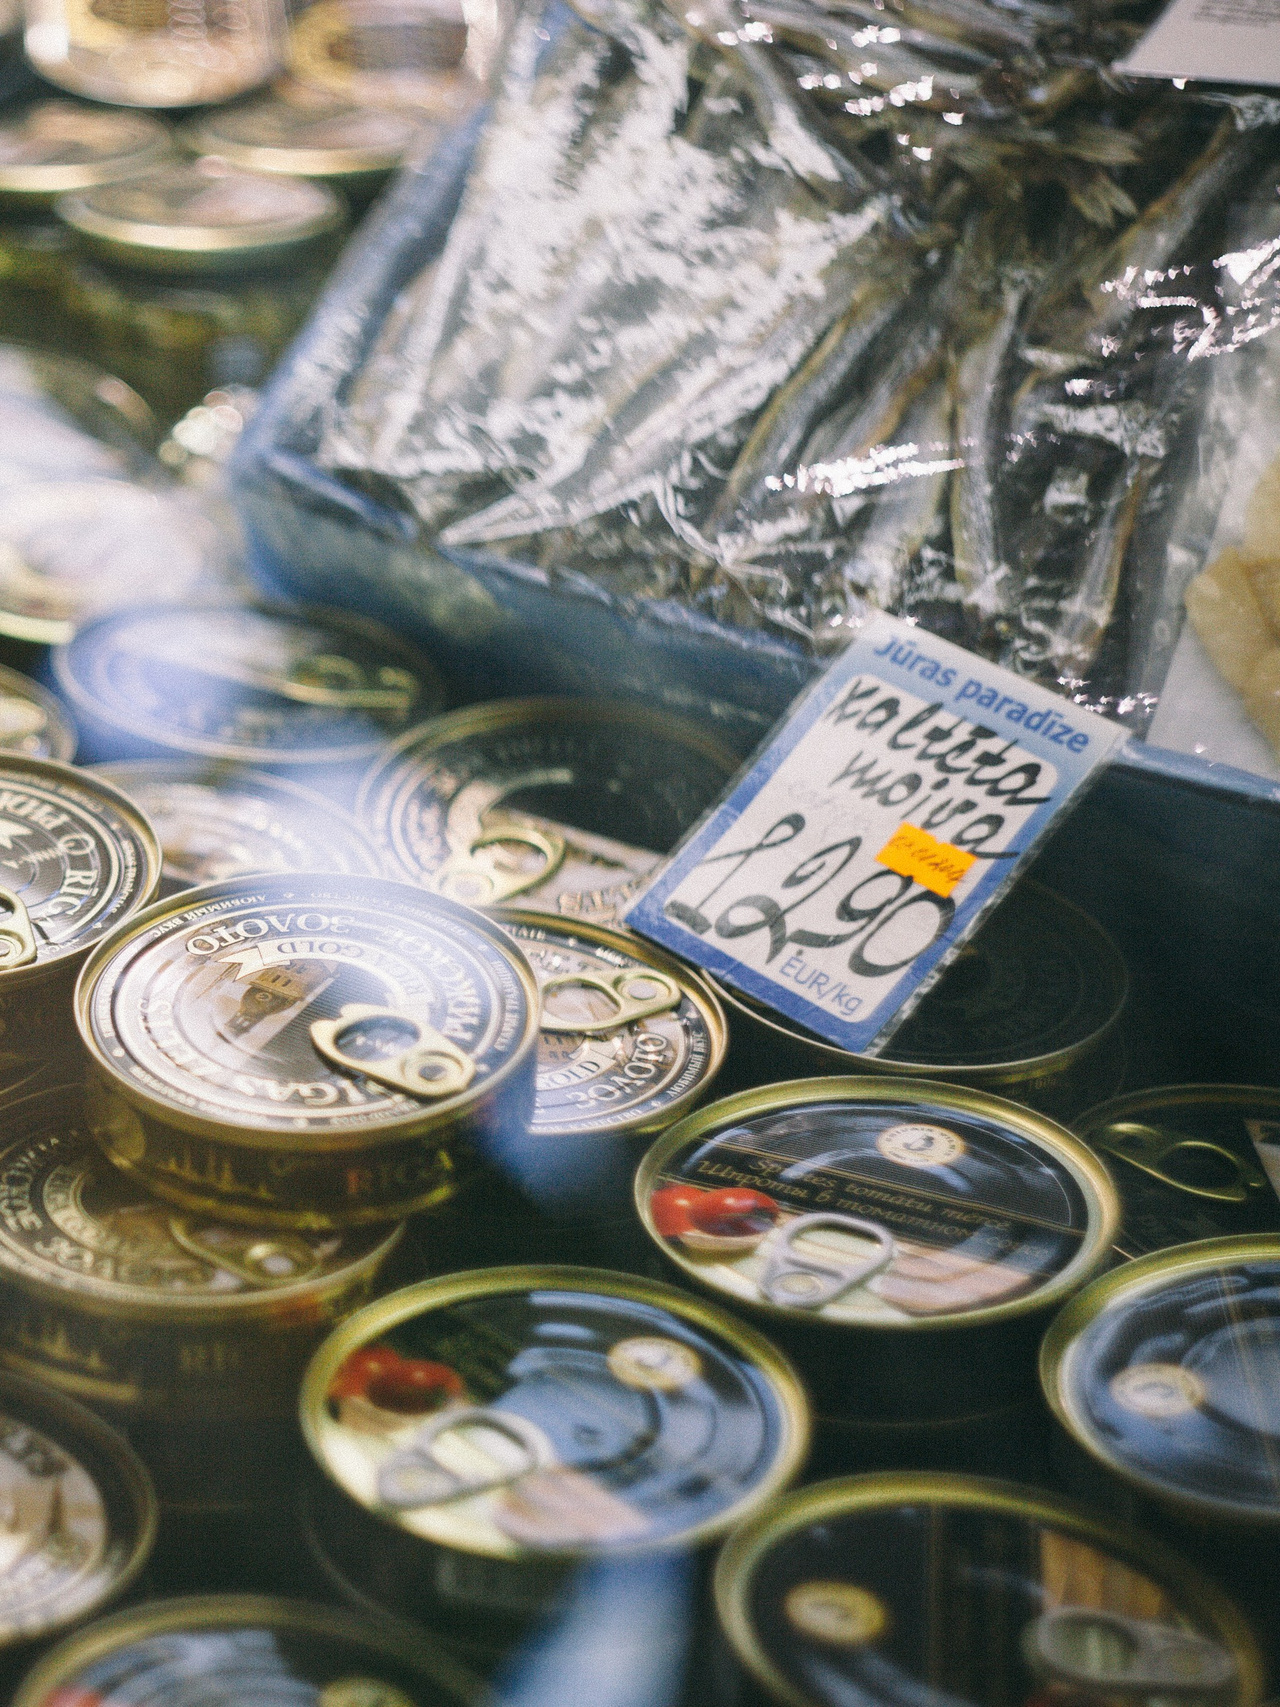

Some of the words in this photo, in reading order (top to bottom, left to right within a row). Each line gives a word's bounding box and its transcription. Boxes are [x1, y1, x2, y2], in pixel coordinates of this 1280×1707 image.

[873, 634, 959, 688] Jūras
[957, 675, 1090, 755] paradīze
[192, 892, 267, 922] ЛЮБИМЫЙ
[152, 913, 191, 938] ВКУС
[186, 913, 357, 956] ЗОЛОТО
[275, 938, 365, 961] GOLD
[778, 954, 865, 1018] EUR/kg
